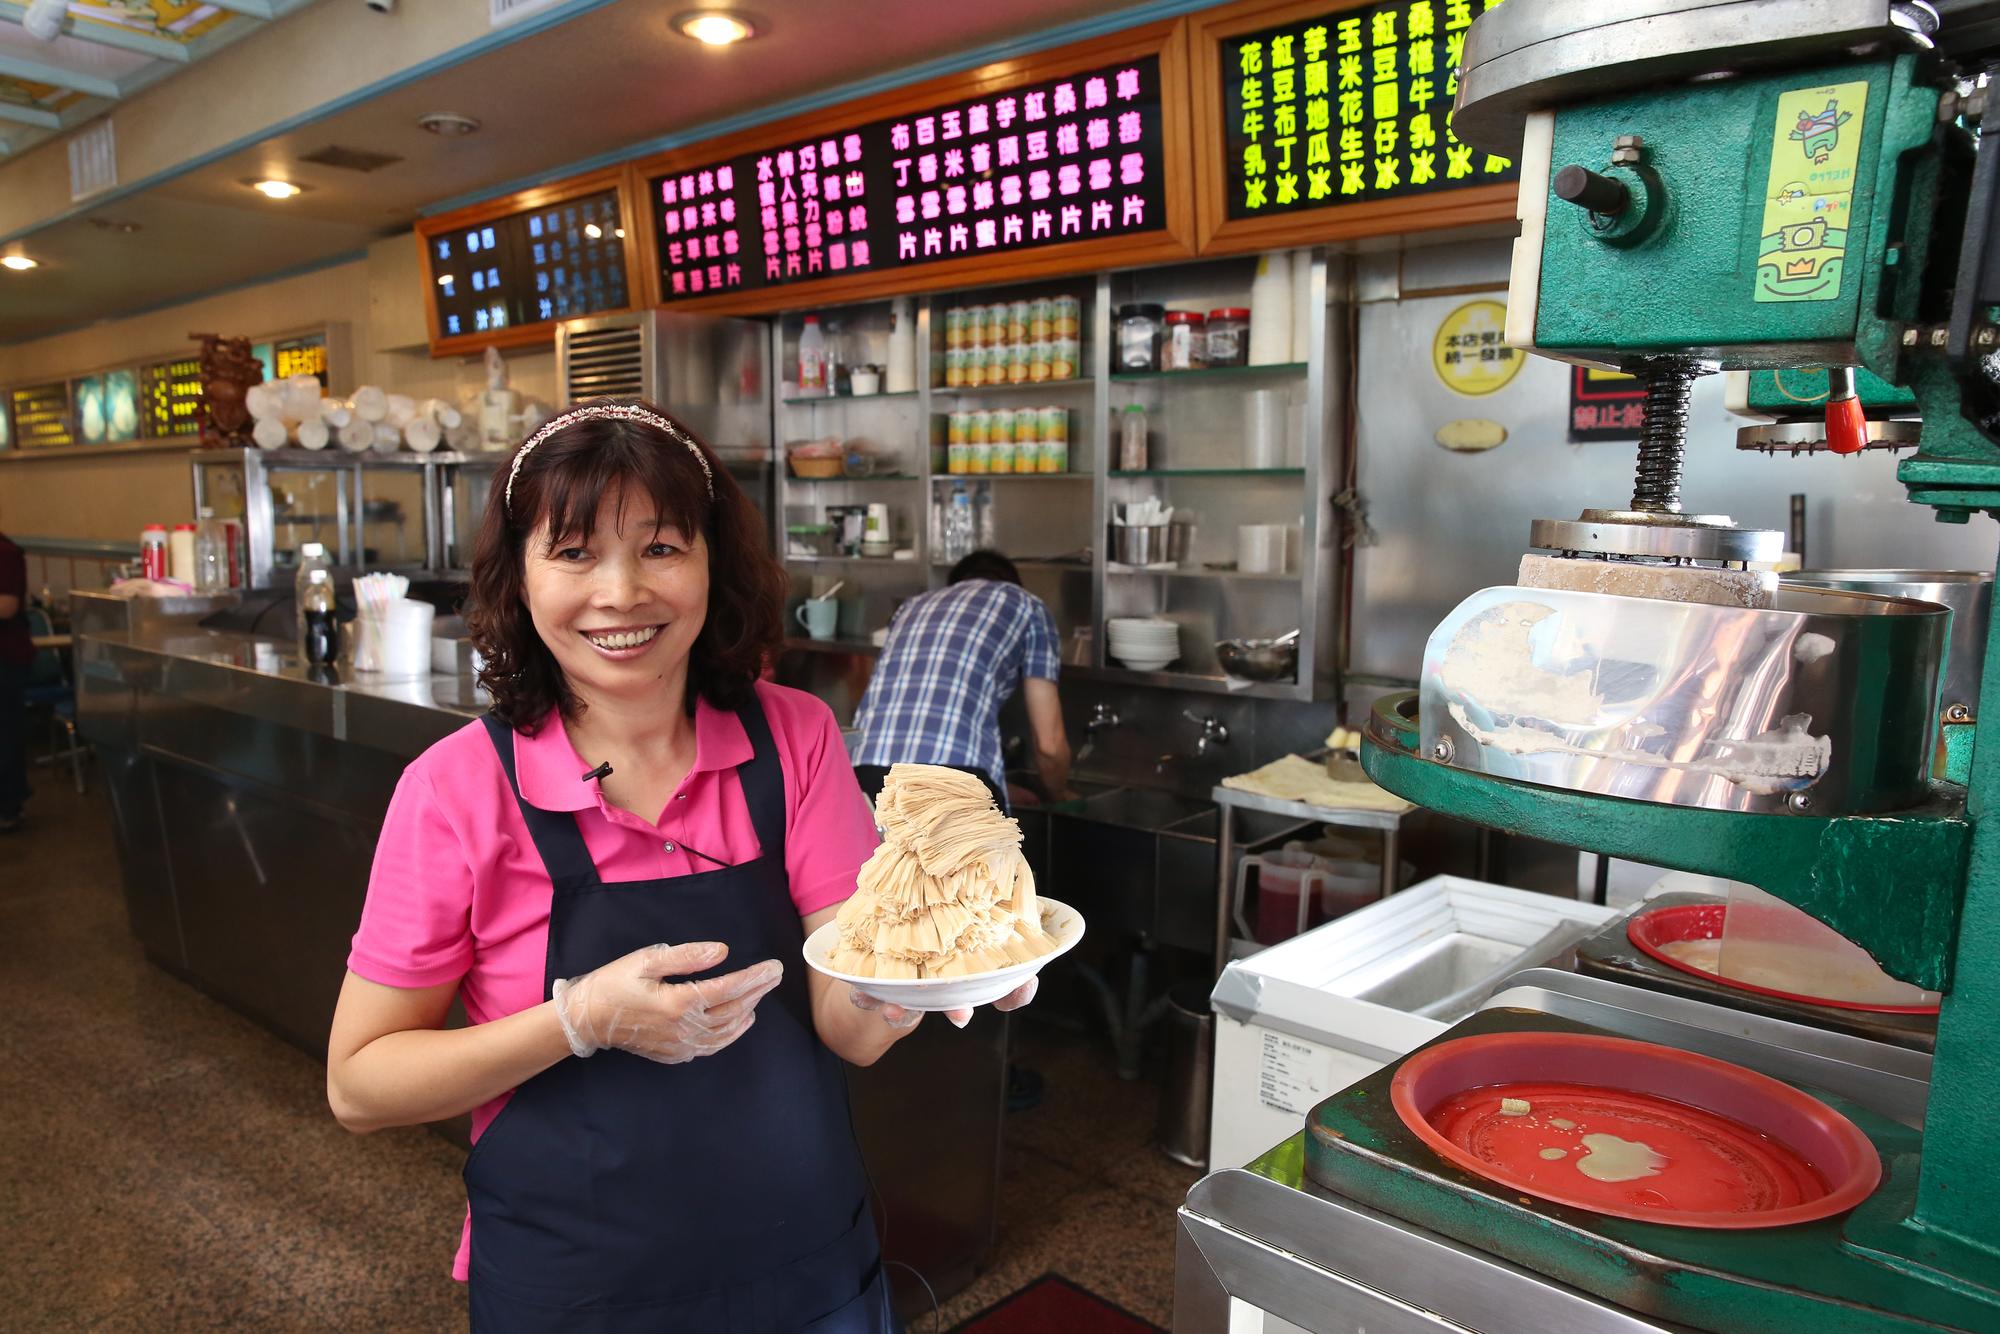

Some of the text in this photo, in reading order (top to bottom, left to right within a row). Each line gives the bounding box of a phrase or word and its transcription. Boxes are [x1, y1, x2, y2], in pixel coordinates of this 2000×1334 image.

[995, 96, 1025, 245] 芋頭雪片
[1023, 91, 1053, 241] 紅豆雪片
[1239, 41, 1268, 209] 花生牛乳冰
[1271, 35, 1300, 205] 紅豆布丁冰
[1304, 25, 1332, 200] 芋頭地瓜冰
[1338, 17, 1366, 195] 玉米花生冰
[697, 170, 723, 288] 抹茶紅豆
[756, 156, 782, 281] 水蜜桃雪片
[777, 150, 802, 277] 情人果雪片
[798, 144, 823, 273] 巧克力雪片
[890, 123, 918, 261] 布丁雪片
[915, 116, 943, 257] 百香雪片
[941, 110, 969, 253] 玉米雪片
[1445, 347, 1514, 363] 統一發票
